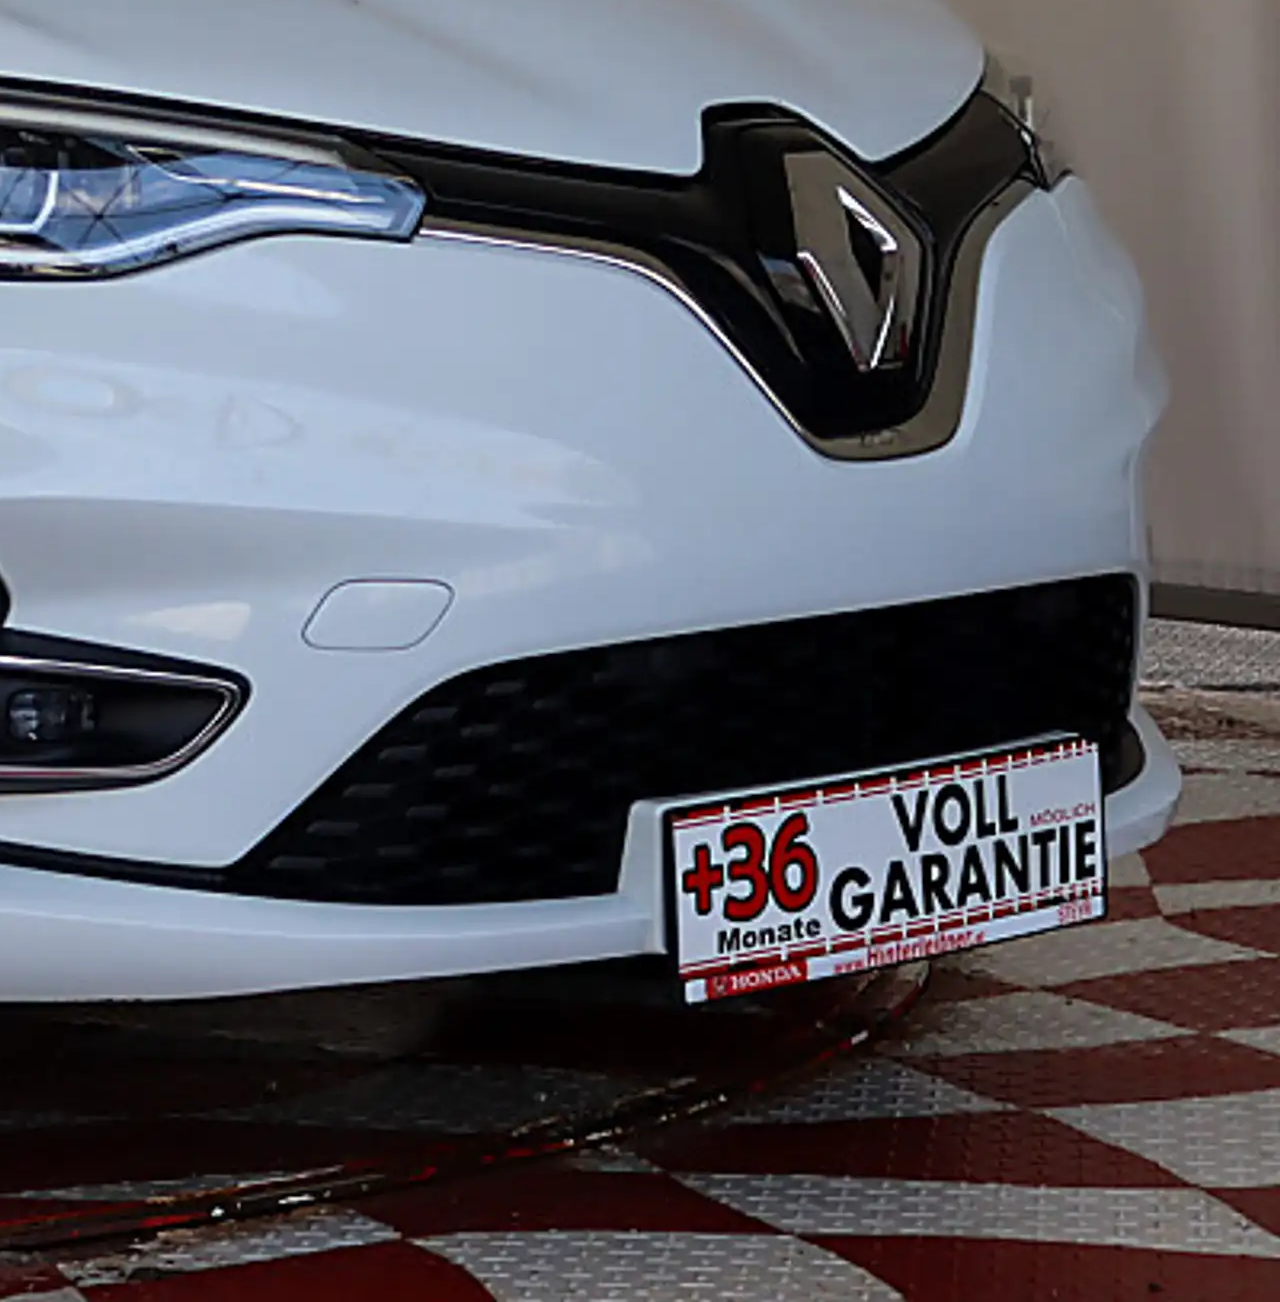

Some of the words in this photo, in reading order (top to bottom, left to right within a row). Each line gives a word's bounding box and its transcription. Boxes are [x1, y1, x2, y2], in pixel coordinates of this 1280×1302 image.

[892, 774, 1019, 852] VOLL
[682, 811, 819, 922] +36
[829, 819, 1096, 941] GARANTIE
[717, 917, 821, 954] Monate
[730, 964, 802, 991] HONDA
